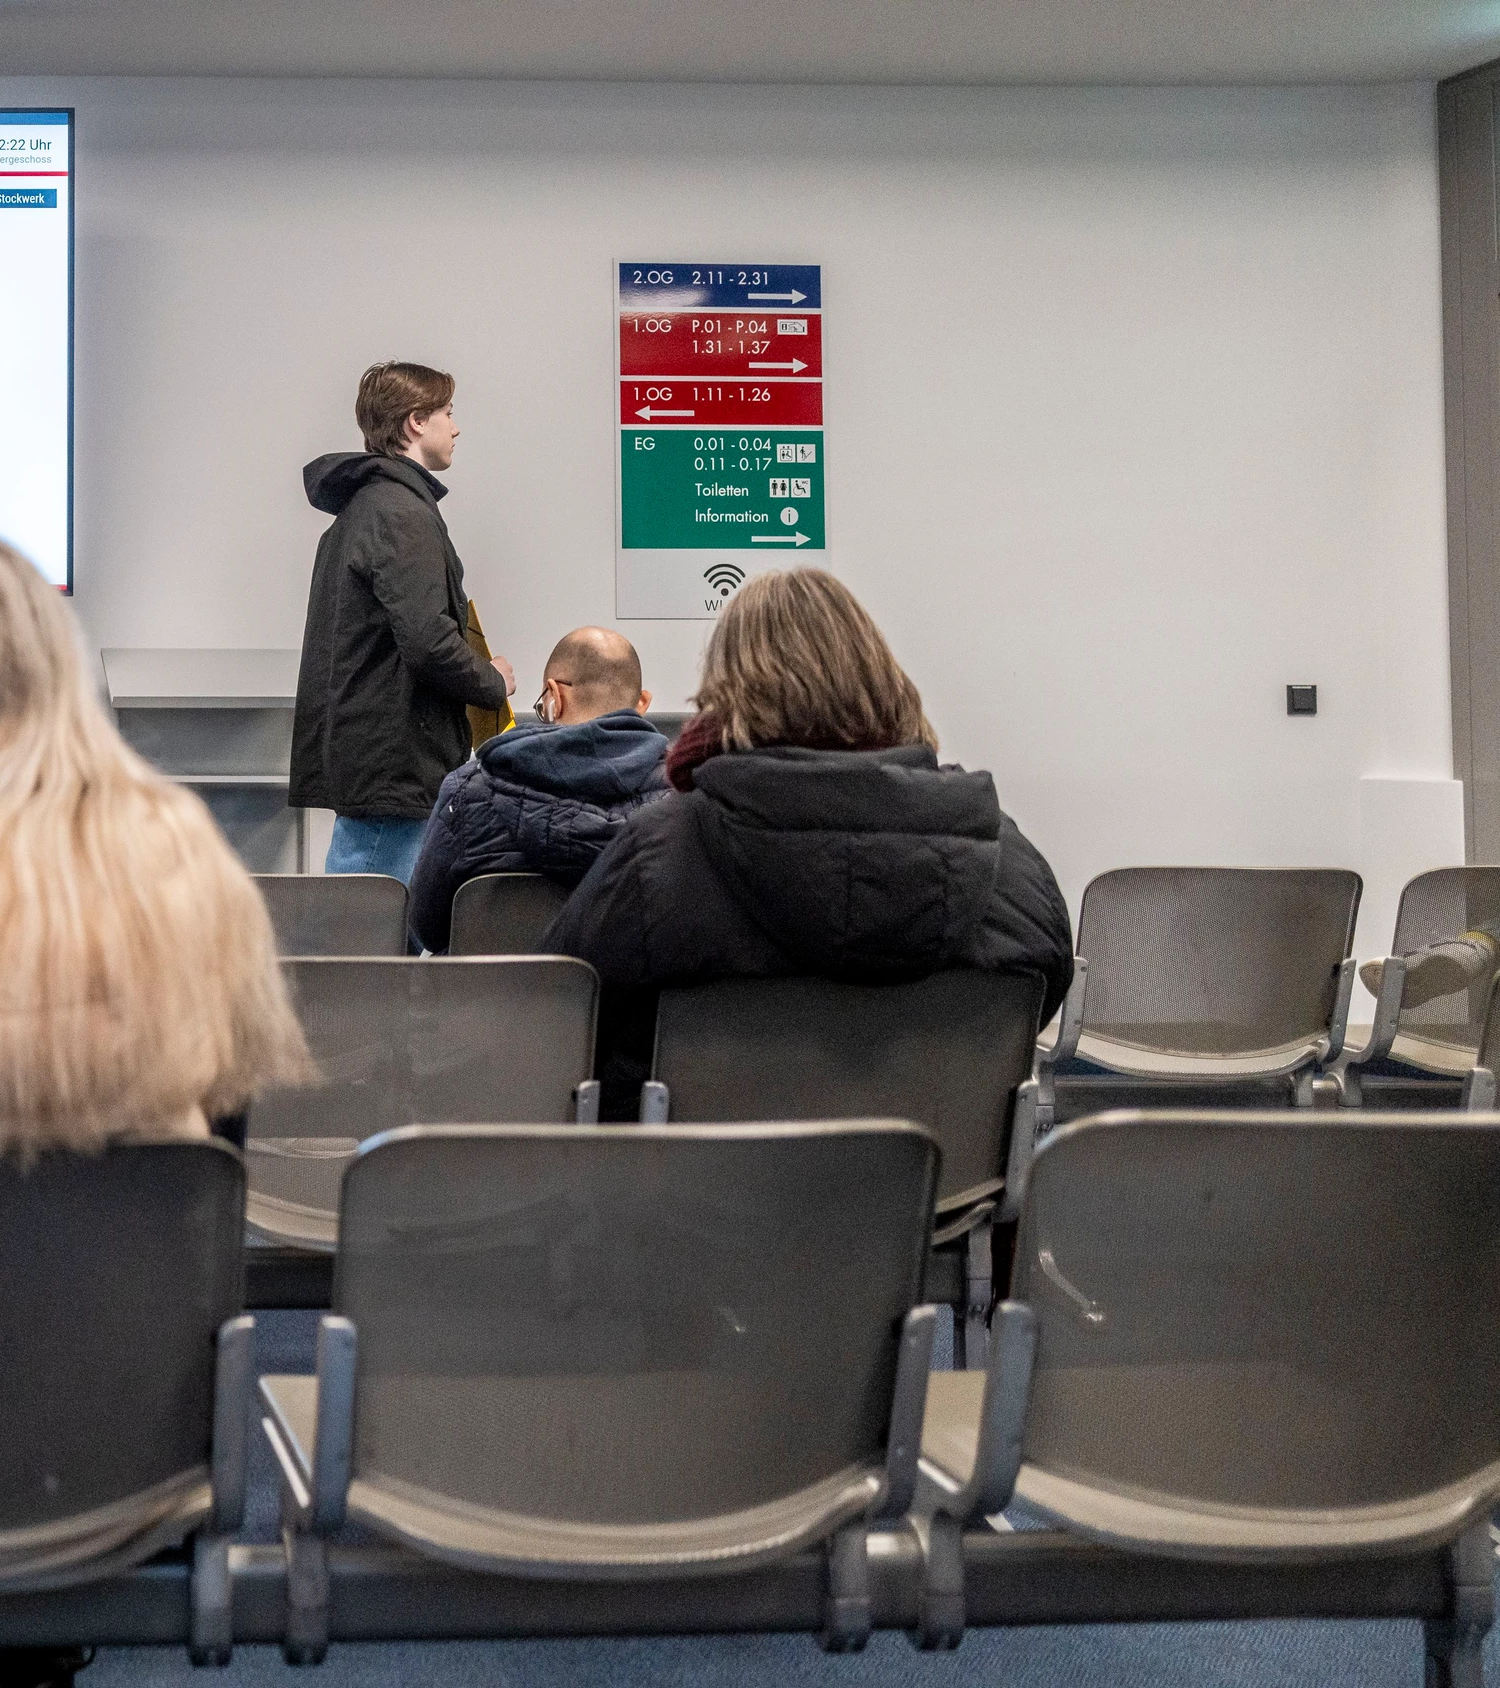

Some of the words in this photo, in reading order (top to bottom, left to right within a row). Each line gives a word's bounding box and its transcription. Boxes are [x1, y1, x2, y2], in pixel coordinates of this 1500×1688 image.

[29, 139, 51, 151] Uhr
[633, 270, 674, 284] 2.OG
[692, 271, 723, 285] 2.11
[738, 271, 768, 285] 2.31
[633, 319, 672, 333] 1.OG
[692, 319, 721, 333] P.01
[736, 320, 768, 334] P.04
[693, 340, 722, 354] 1.31
[739, 340, 771, 354] 1.37
[634, 387, 673, 401] 1.OG
[693, 387, 722, 401] 1.11
[739, 387, 771, 402] 1.26
[634, 437, 656, 451] EG
[694, 437, 725, 451] 0.01
[739, 437, 772, 451] 0.04
[694, 457, 725, 471] 0.11
[739, 457, 772, 471] 0.17
[695, 482, 749, 497] Toiletten
[695, 507, 769, 523] Information
